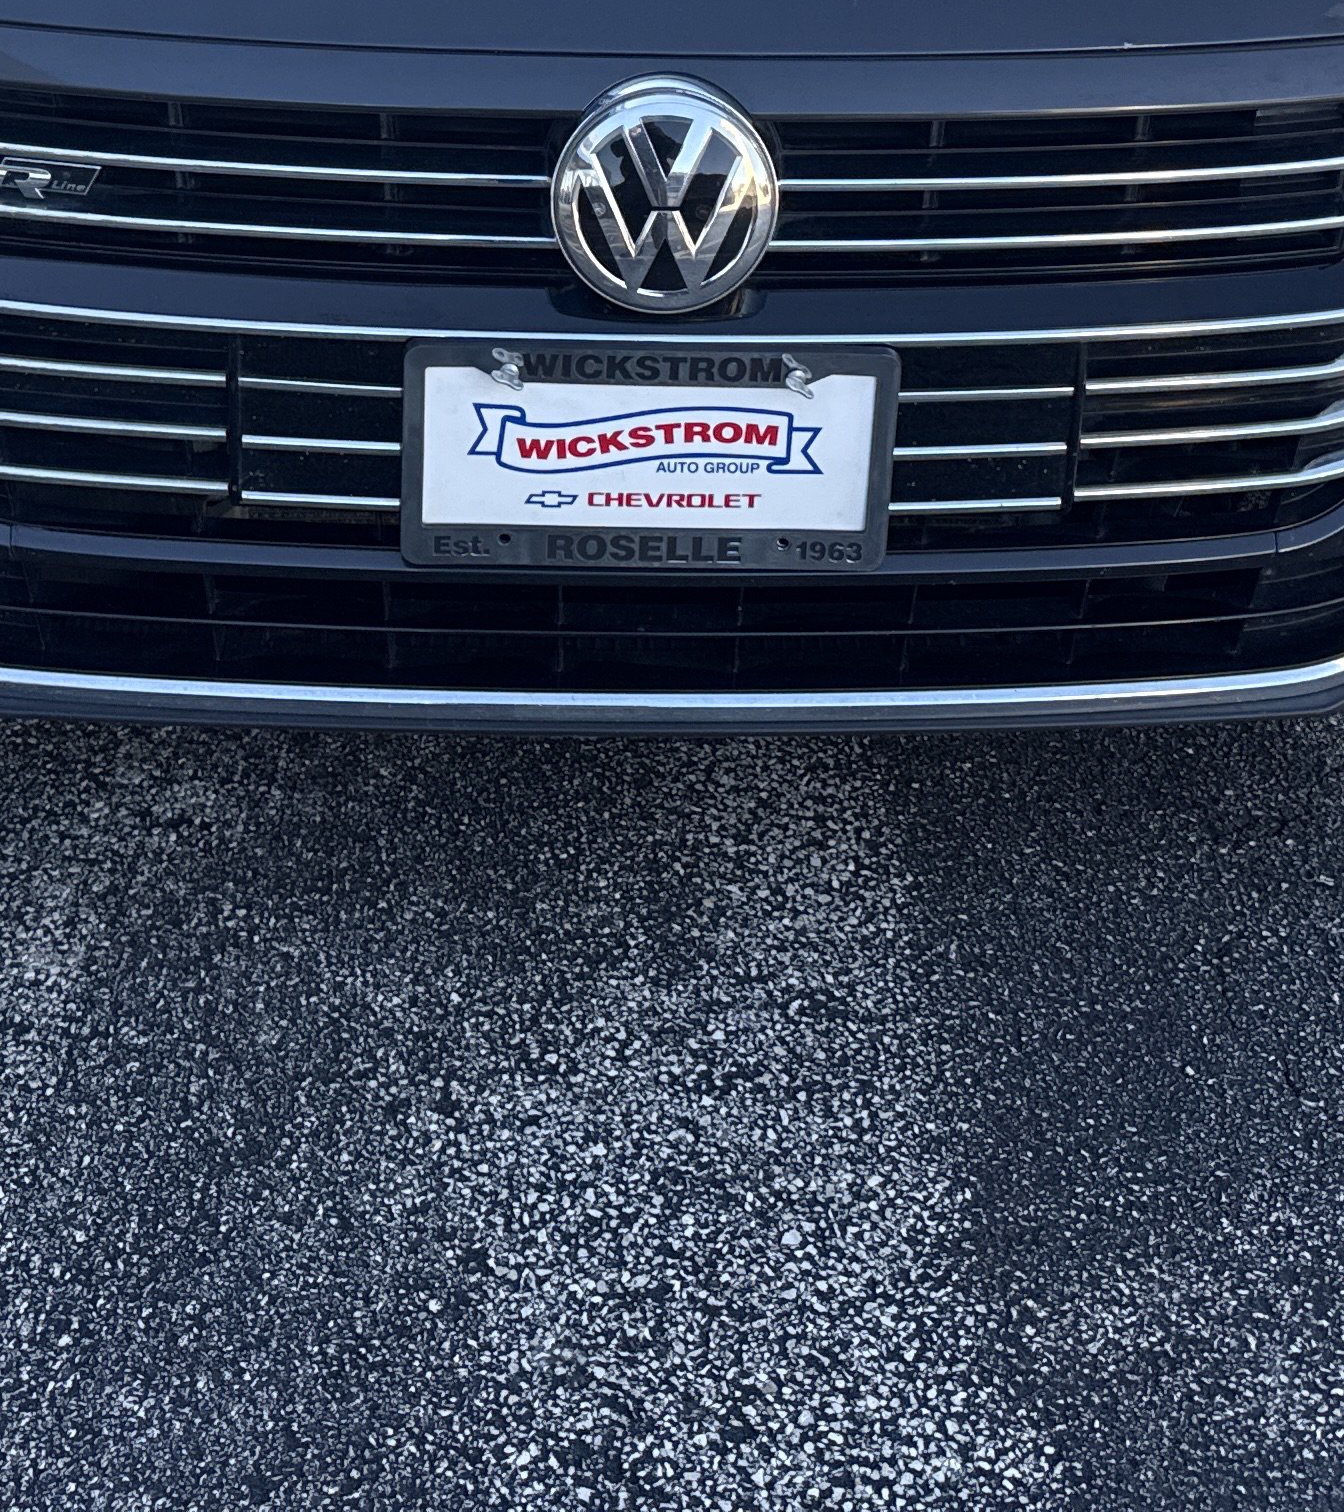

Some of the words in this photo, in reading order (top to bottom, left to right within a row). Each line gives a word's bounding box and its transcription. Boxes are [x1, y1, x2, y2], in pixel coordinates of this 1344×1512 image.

[522, 352, 783, 383] WICKSTROM
[516, 422, 779, 460] WICKSTROM
[656, 461, 699, 474] AUTO
[703, 462, 760, 474] GROUP
[587, 492, 762, 509] CHEVROLET
[432, 536, 491, 557] Est.
[546, 534, 743, 565] ROSELLE
[795, 541, 863, 564] 1963
